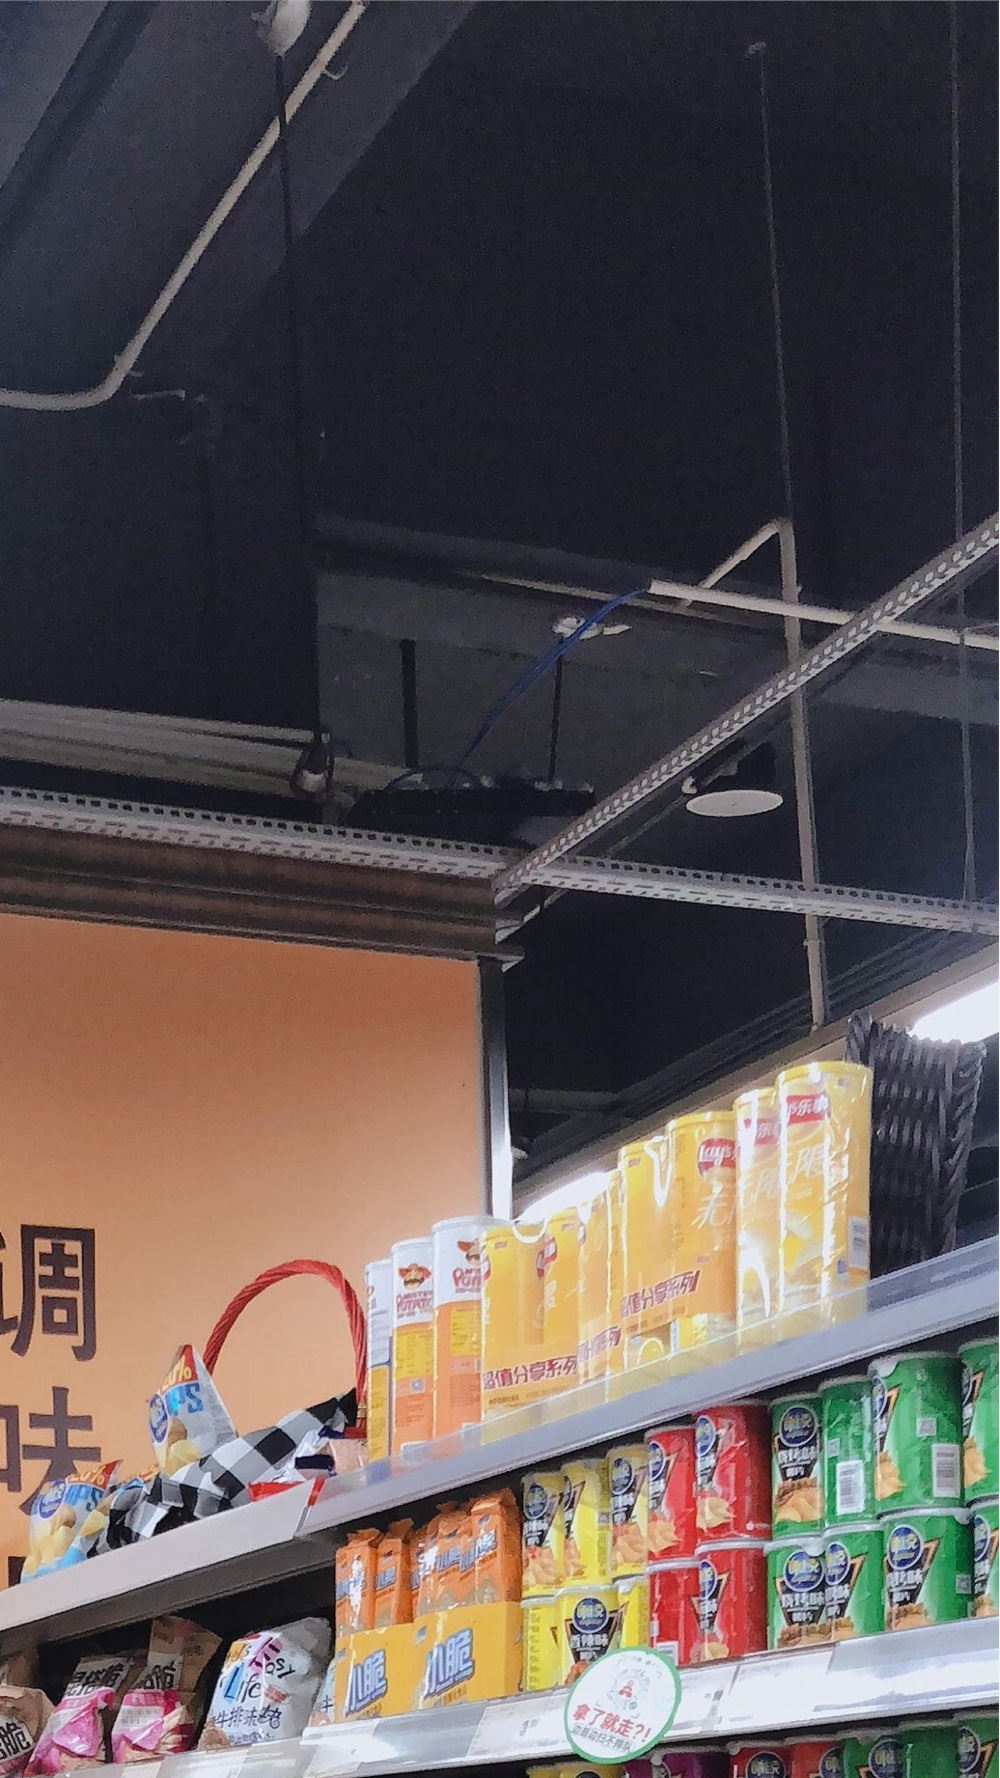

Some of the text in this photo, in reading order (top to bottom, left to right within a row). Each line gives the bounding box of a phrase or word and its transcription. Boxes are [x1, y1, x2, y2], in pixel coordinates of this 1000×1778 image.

[483, 1355, 577, 1390] 超值分享系列
[572, 1704, 652, 1742] 拿了就走?!
